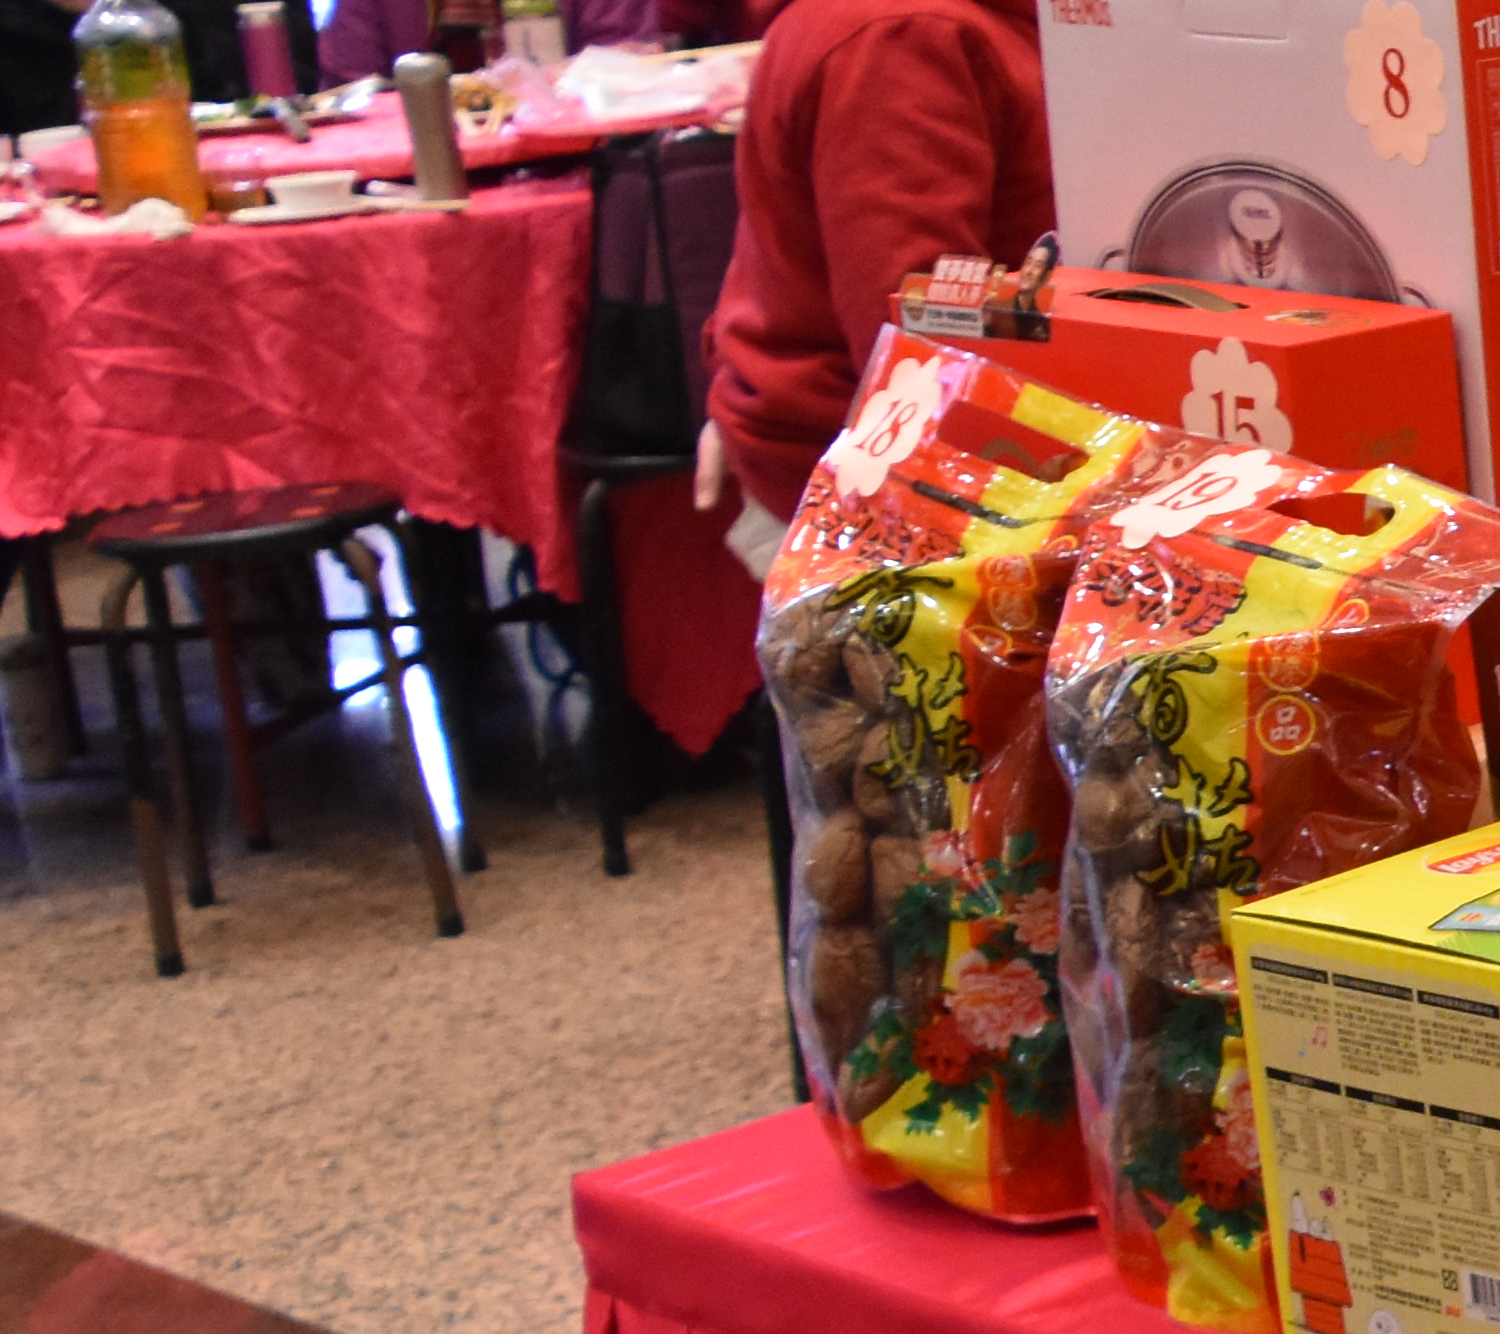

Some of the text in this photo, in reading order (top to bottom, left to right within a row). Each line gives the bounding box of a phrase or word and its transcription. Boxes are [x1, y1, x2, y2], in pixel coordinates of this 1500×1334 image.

[1382, 48, 1410, 118] 8
[855, 399, 918, 457] 18
[1210, 390, 1260, 445] 15
[1154, 472, 1239, 511] 19
